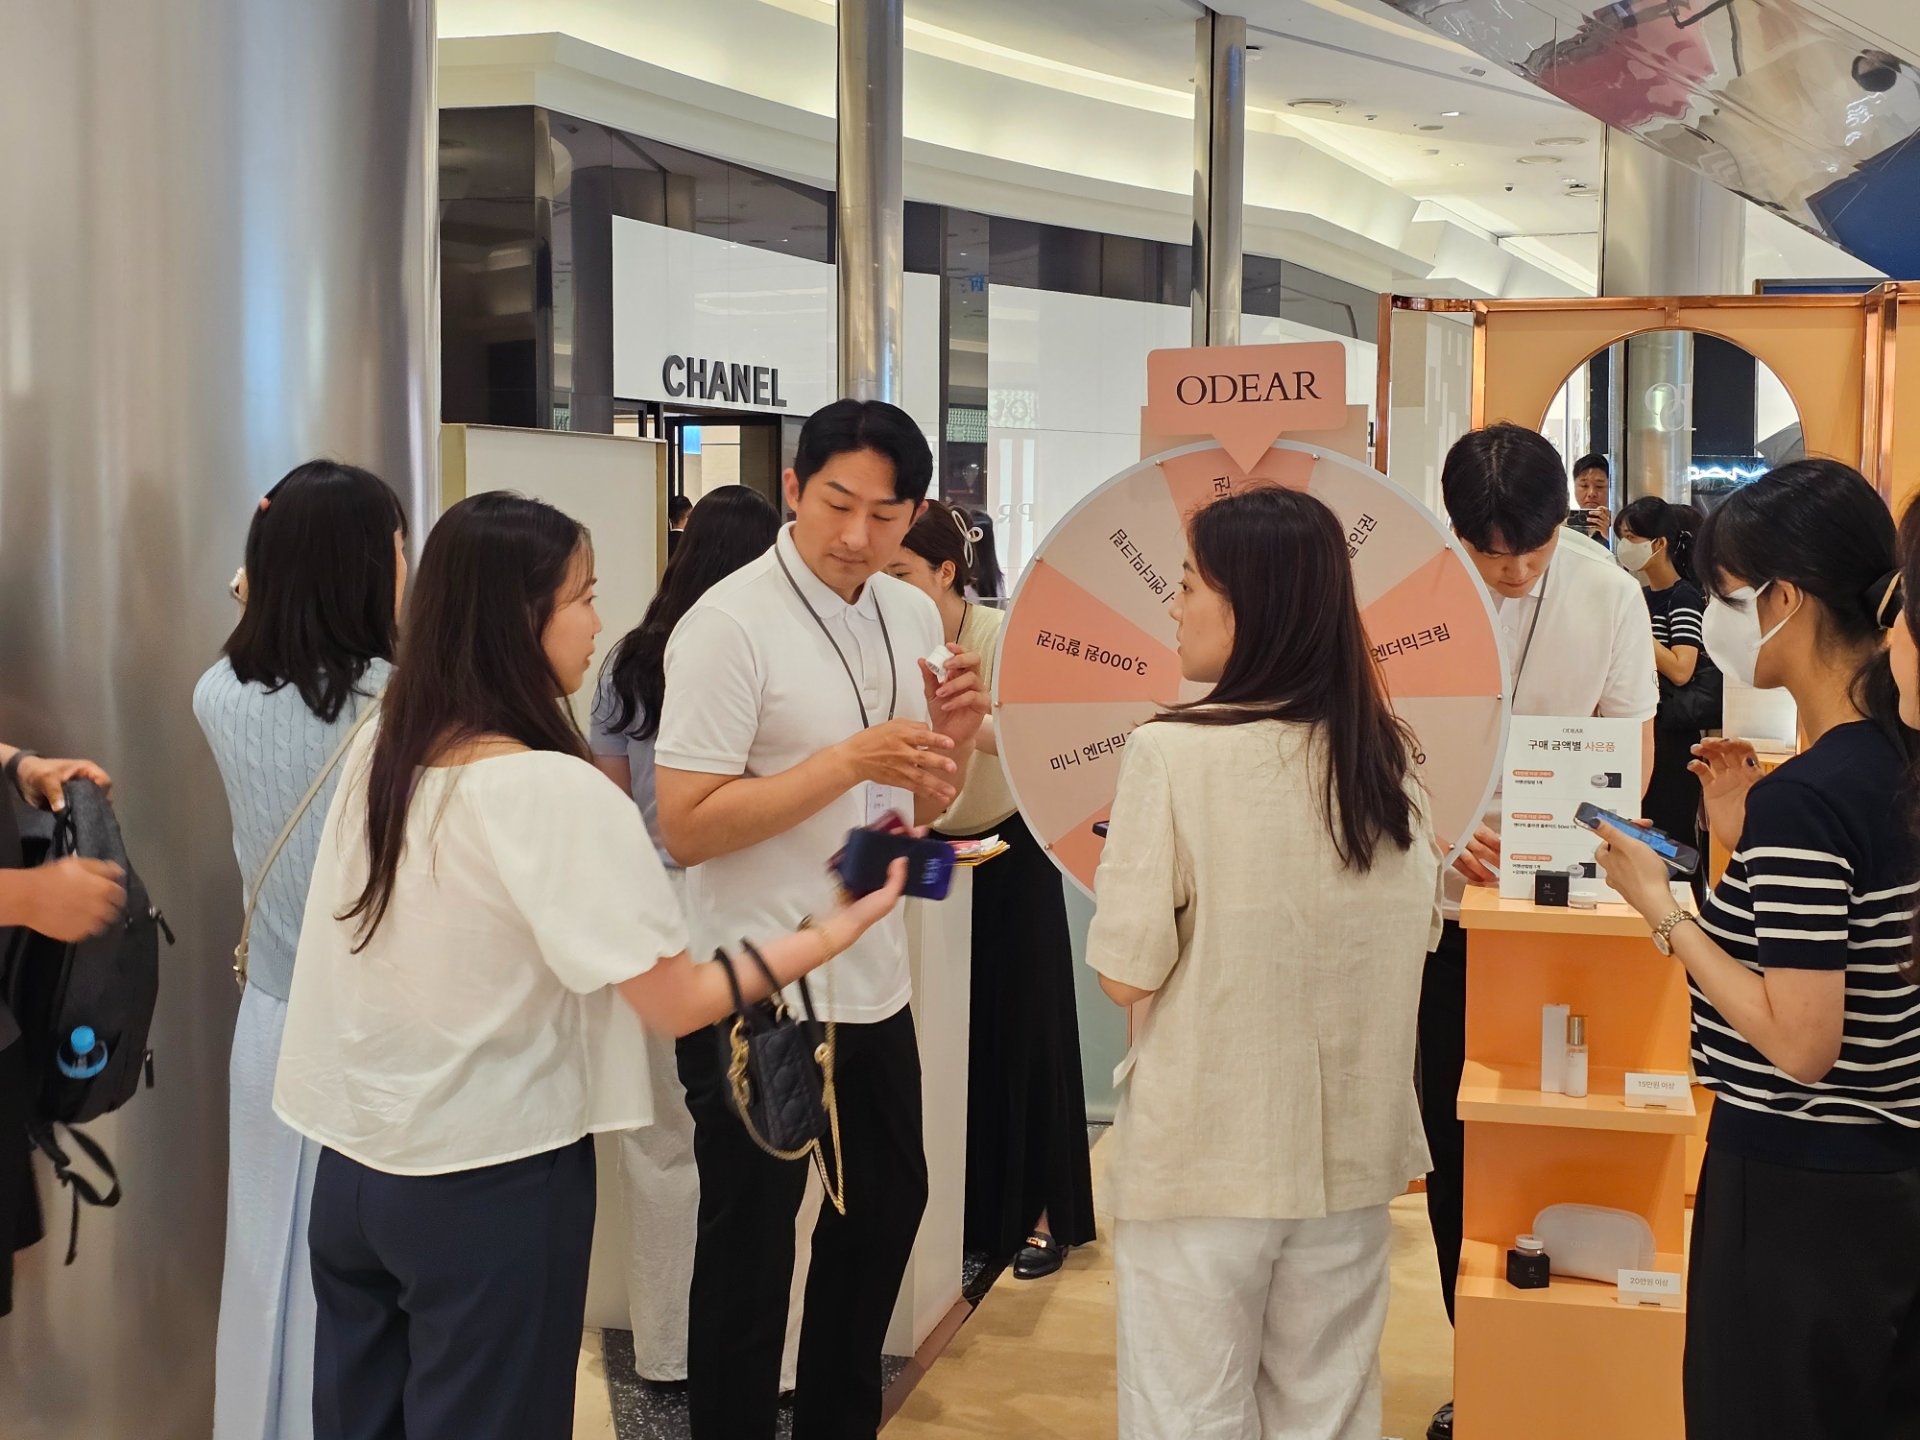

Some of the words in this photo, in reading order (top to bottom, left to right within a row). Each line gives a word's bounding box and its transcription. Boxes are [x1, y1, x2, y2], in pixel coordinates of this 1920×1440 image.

[662, 354, 787, 407] CHANEL
[1176, 371, 1322, 406] ODEAR
[1036, 629, 1081, 657] 할인권
[1370, 622, 1451, 663] 엔더믹크림
[1084, 644, 1148, 676] 3,000원
[1050, 749, 1081, 770] 미니
[1528, 739, 1549, 751] 구매
[1551, 740, 1582, 752] 금액별
[1584, 741, 1616, 753] 사은품
